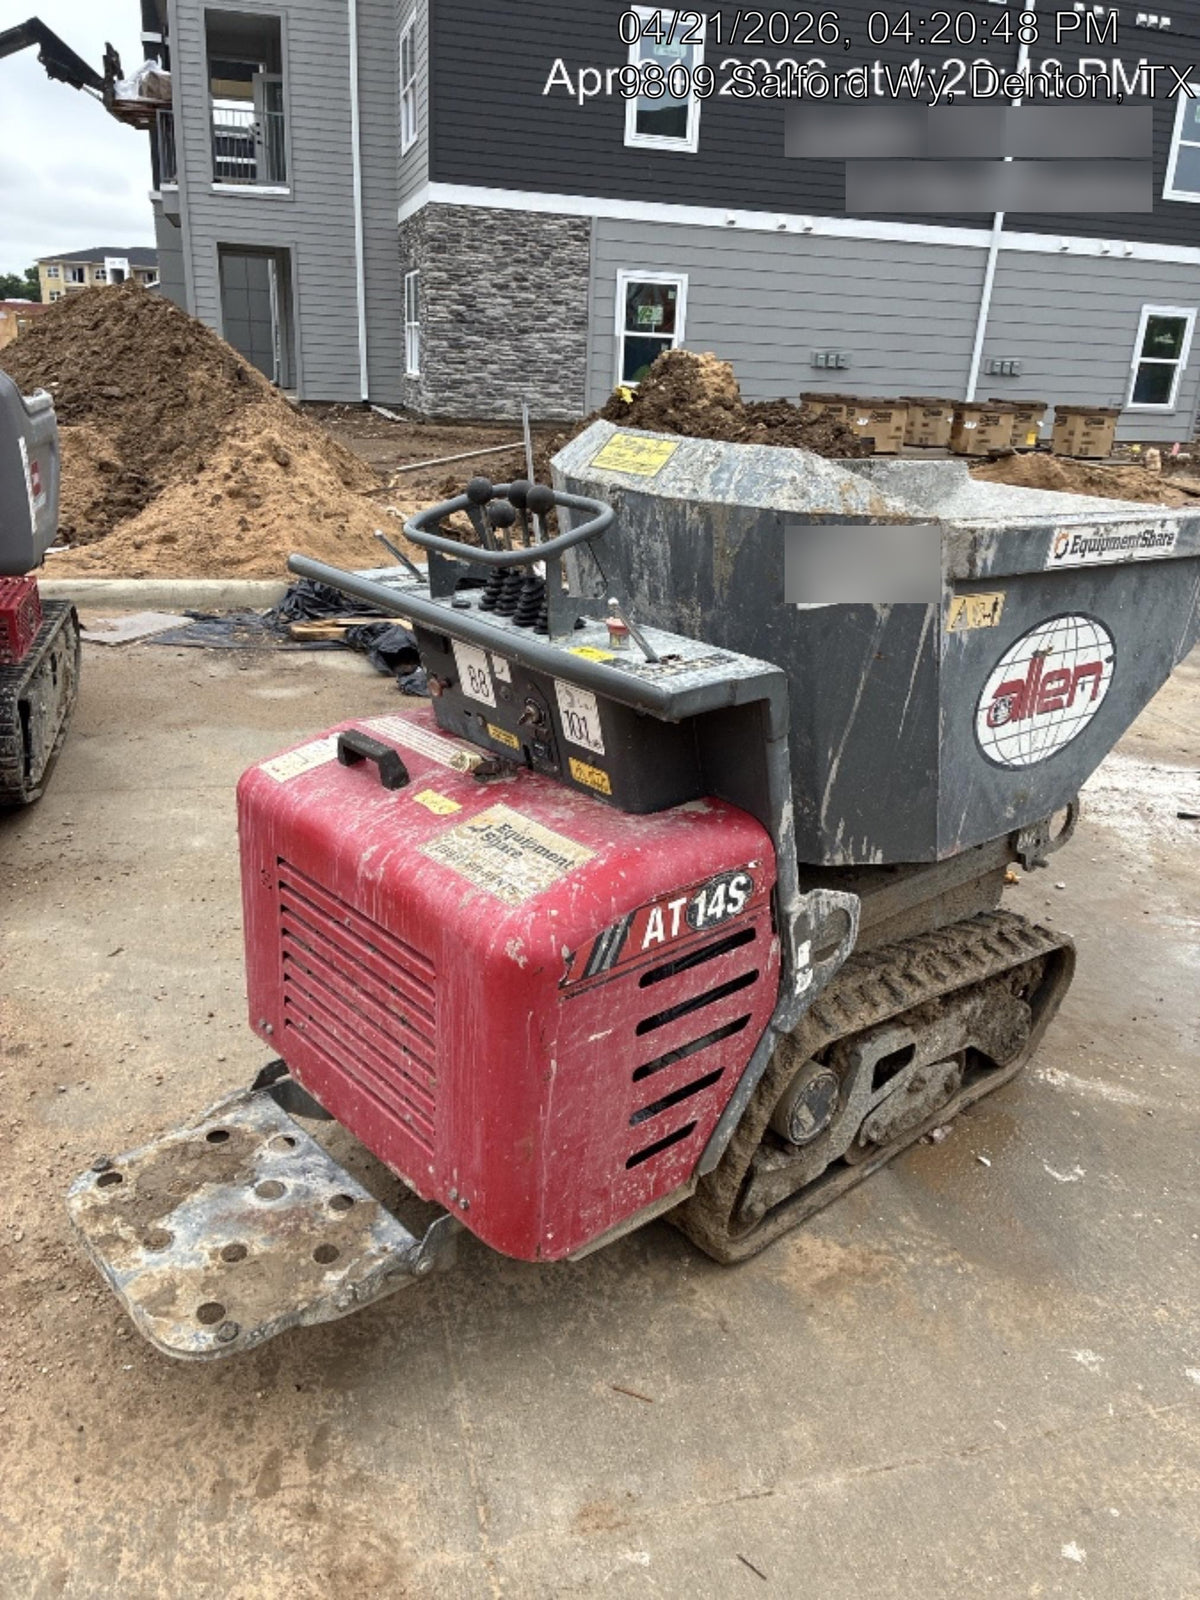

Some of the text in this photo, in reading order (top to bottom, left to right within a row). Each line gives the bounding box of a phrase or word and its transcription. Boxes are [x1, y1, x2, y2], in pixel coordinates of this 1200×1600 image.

[1069, 529, 1175, 557] EquipmentShare
[467, 665, 489, 698] 88
[986, 653, 1103, 728] allen
[563, 709, 590, 745] 101
[480, 831, 523, 860] Share
[497, 822, 576, 870] Equipment
[641, 875, 748, 950] AT 14S
